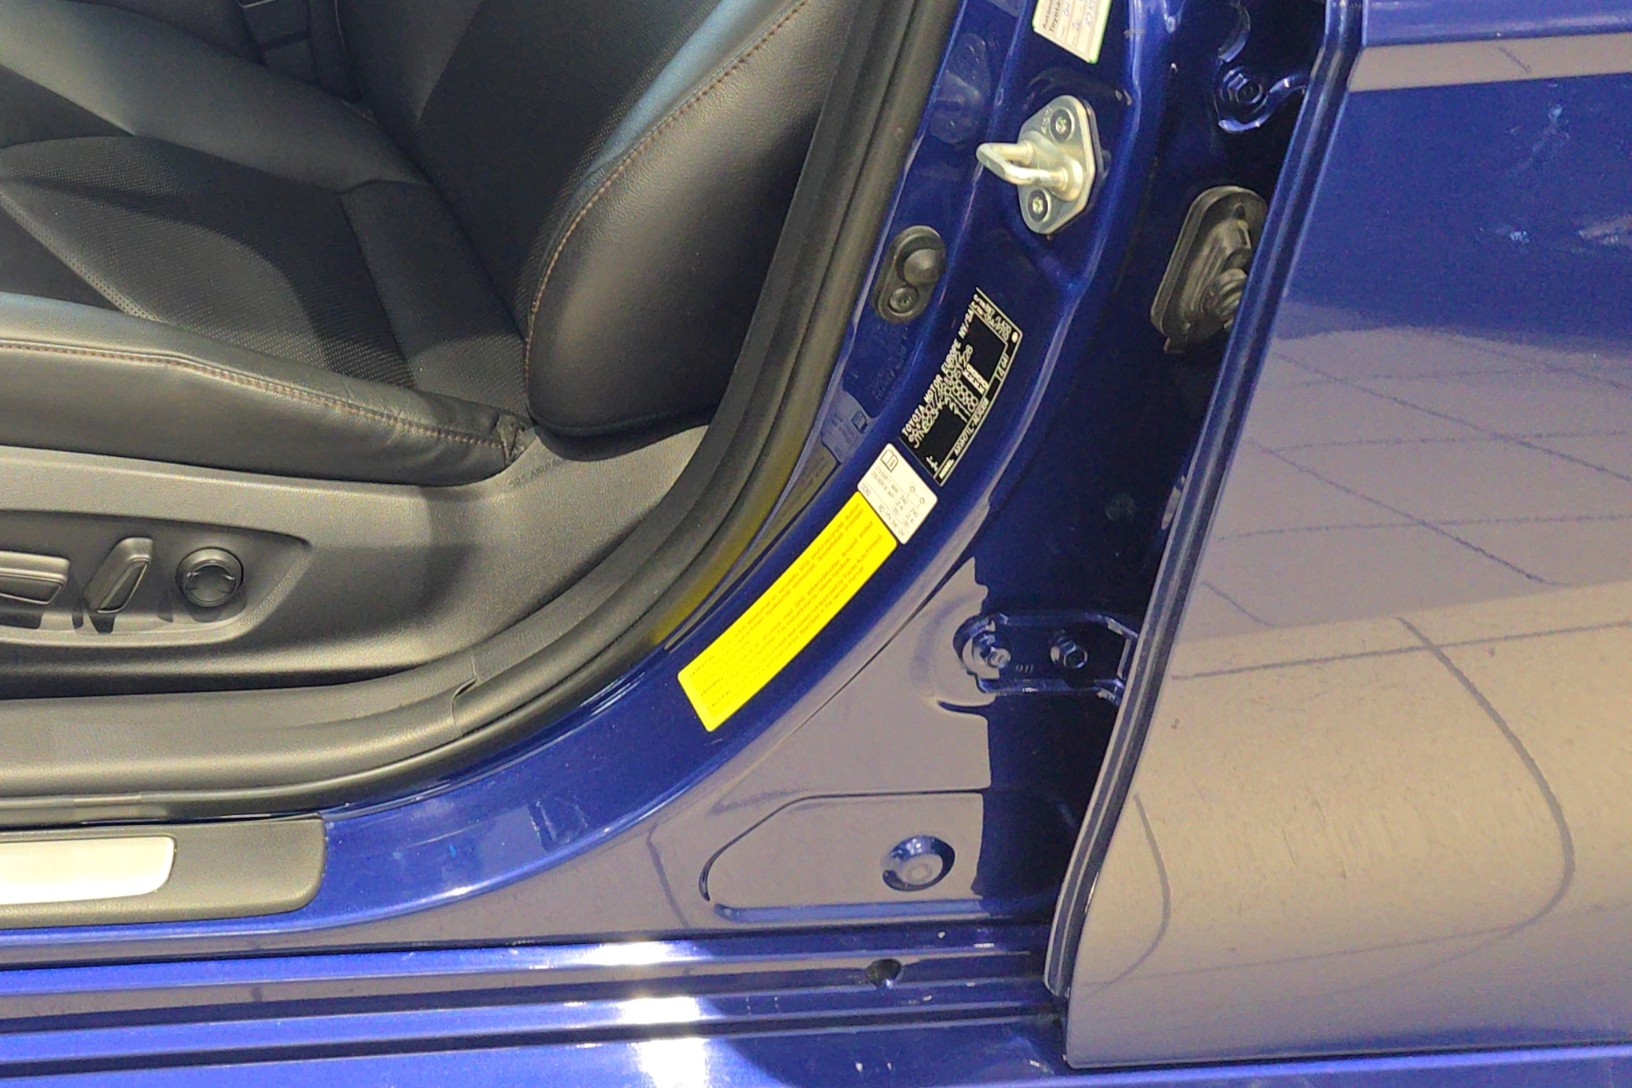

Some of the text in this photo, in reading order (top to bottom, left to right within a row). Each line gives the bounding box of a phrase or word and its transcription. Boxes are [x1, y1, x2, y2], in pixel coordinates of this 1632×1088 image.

[902, 308, 975, 437] TOYOTA MOTOR EUROPE NV/SA
